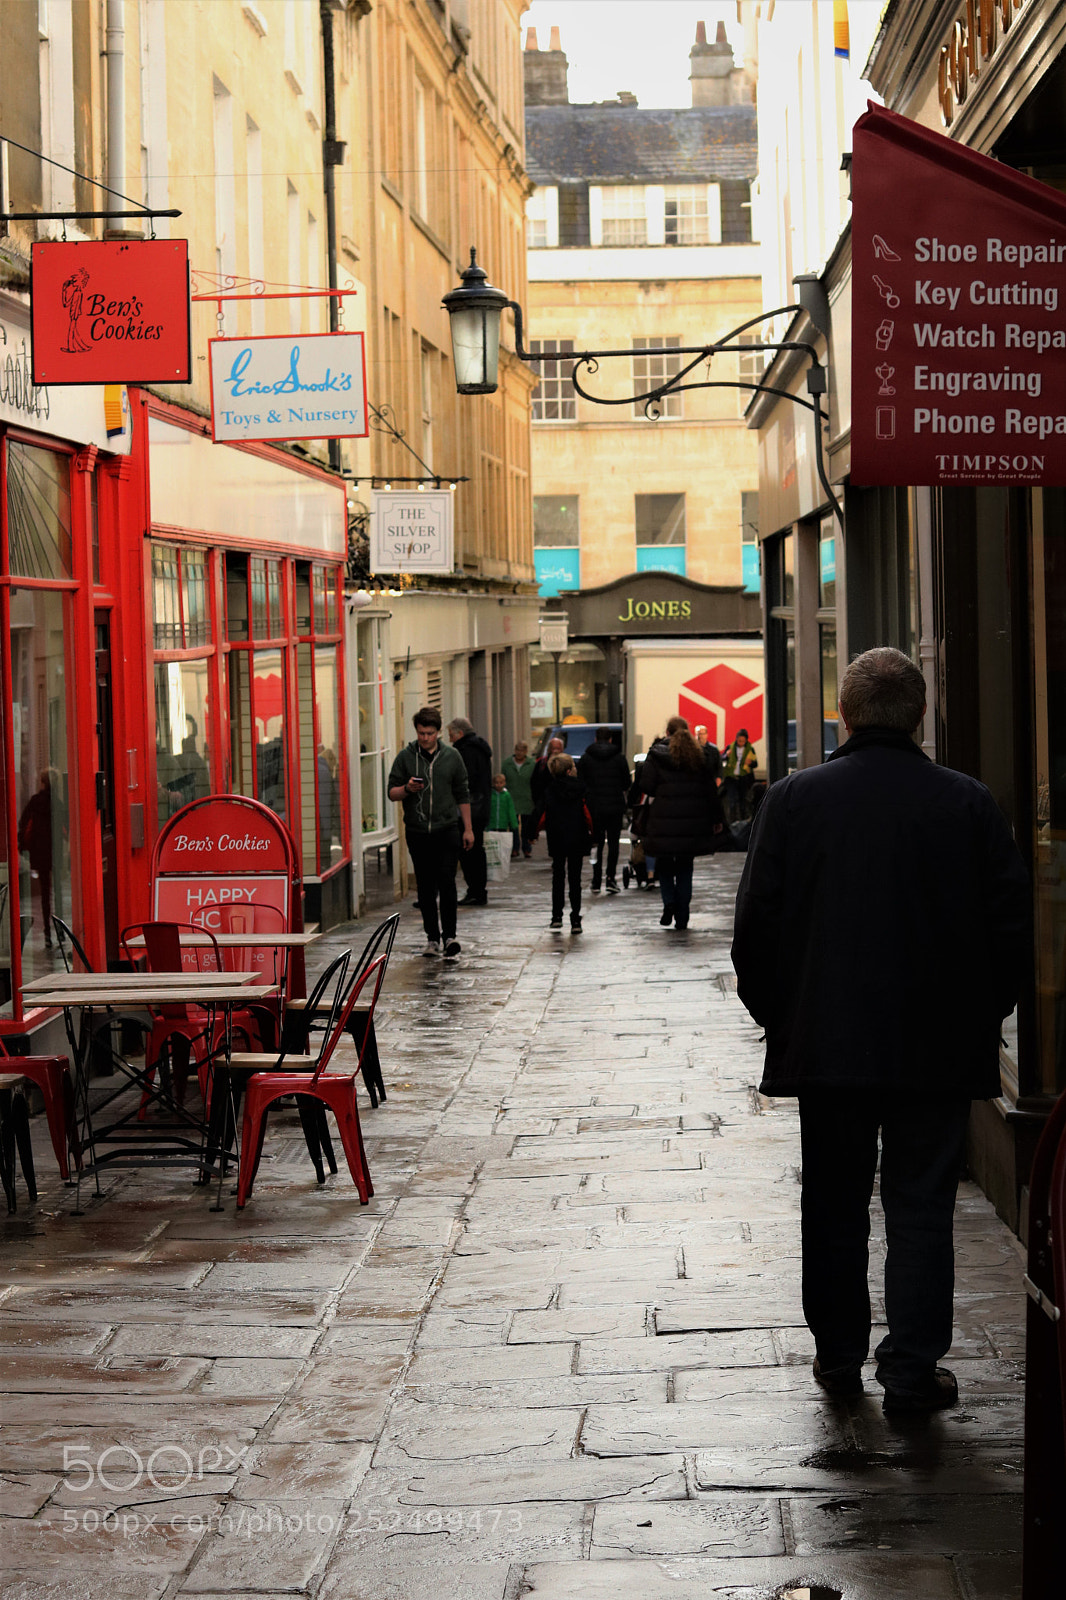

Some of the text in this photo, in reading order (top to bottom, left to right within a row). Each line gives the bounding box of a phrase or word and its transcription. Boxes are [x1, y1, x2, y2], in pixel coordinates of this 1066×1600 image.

[914, 237, 978, 263] Shoe
[87, 294, 144, 317] Ben's
[914, 280, 1058, 311] Key Cutting
[90, 317, 164, 341] Cookies
[913, 323, 996, 348] Watch
[223, 345, 352, 397] Eric Snook's
[914, 365, 1042, 397] Engraving
[220, 407, 358, 428] Toys & Nursery
[913, 408, 996, 434] Phone
[935, 454, 1046, 471] TIMPSON
[987, 472, 996, 480] by
[1018, 472, 1041, 480] People
[398, 508, 426, 520] THE
[387, 526, 436, 538] SILVER
[394, 543, 431, 555] SHOP
[618, 598, 692, 622] JONES
[174, 834, 270, 851] Ben's Cookies
[186, 888, 257, 906] HAPPY
